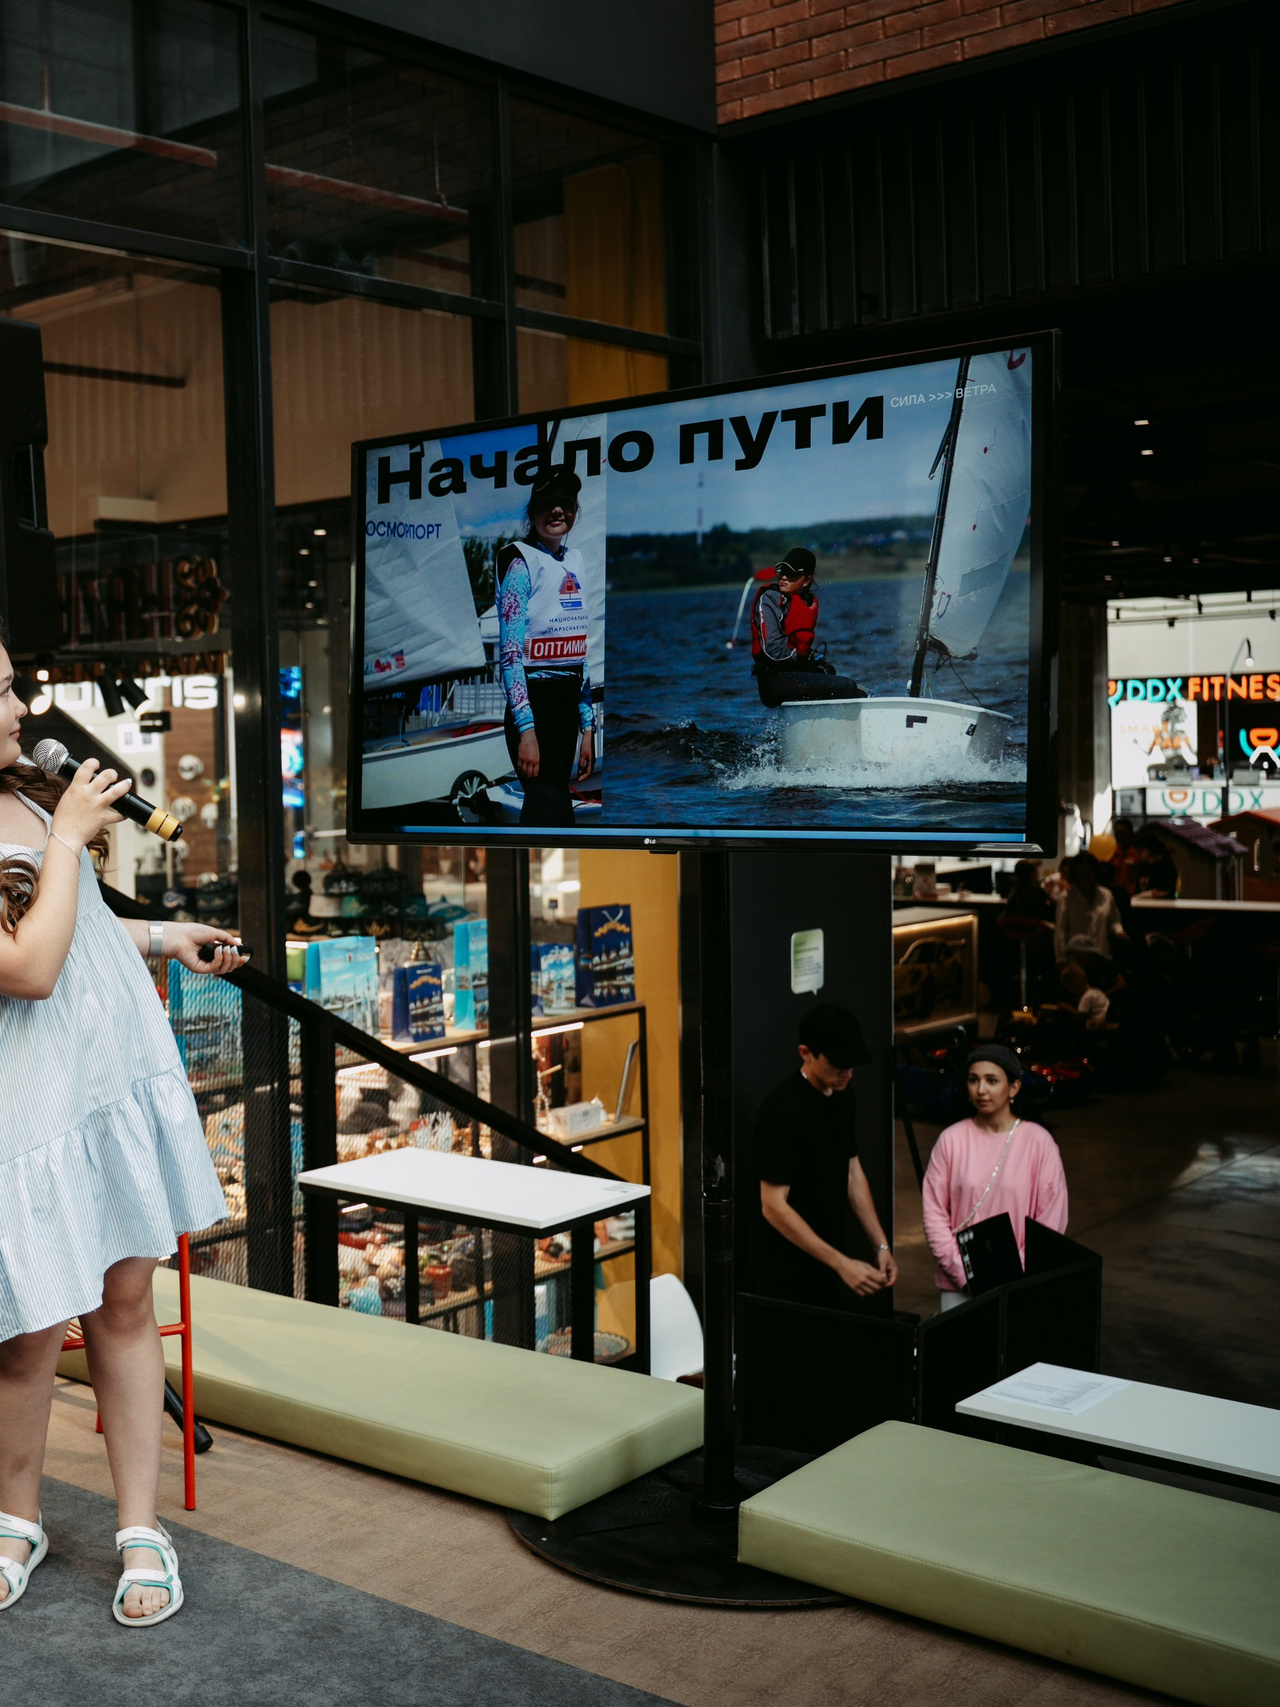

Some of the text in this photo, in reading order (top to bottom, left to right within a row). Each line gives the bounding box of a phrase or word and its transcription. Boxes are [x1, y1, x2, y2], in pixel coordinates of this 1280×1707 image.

[889, 393, 926, 409] СИЛА
[955, 382, 997, 400] ВЕТРА
[377, 395, 885, 505] Начало пути
[1126, 677, 1184, 702] DDX
